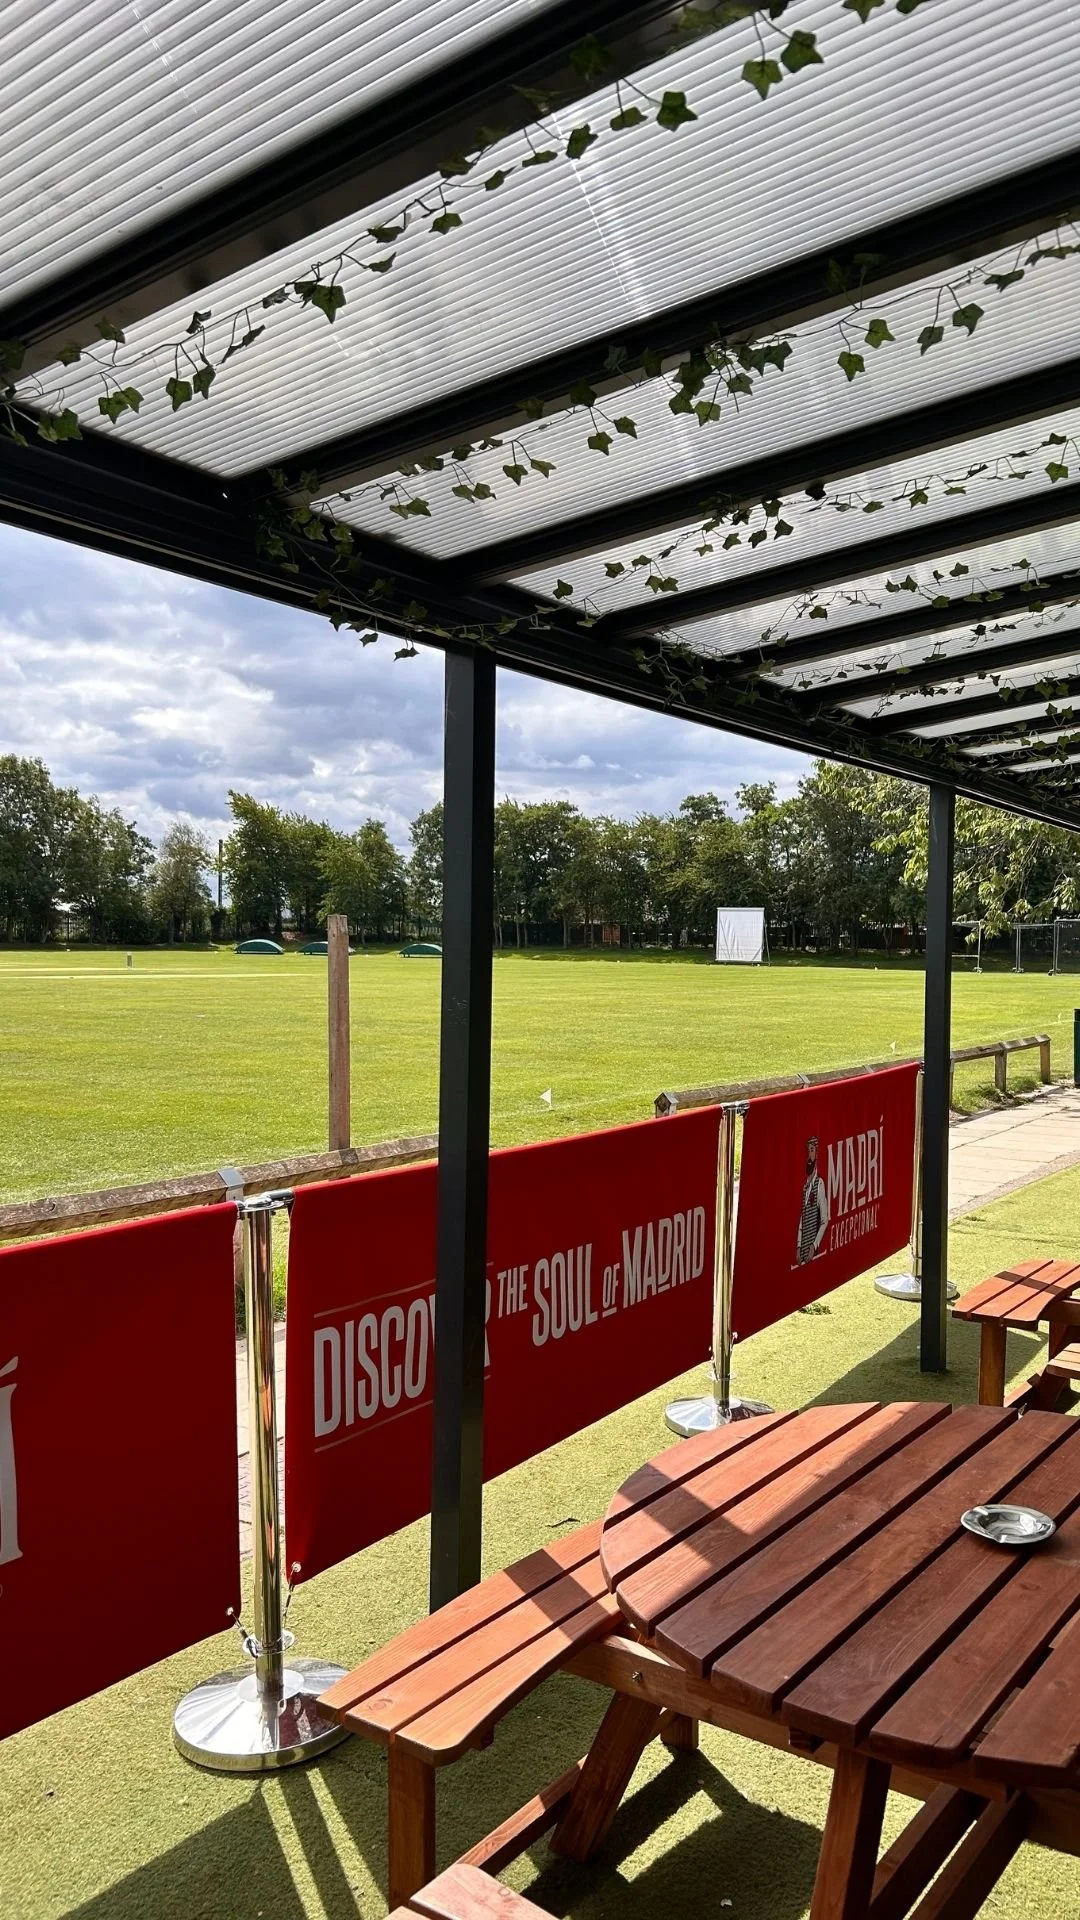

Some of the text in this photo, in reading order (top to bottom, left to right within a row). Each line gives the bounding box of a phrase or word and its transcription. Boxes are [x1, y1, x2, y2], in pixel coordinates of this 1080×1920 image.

[827, 1114, 884, 1221] MADRÍ
[830, 1207, 879, 1252] EXCEPCIONAL
[313, 1205, 706, 1438] DISCO THE SOUL OF MADRID
